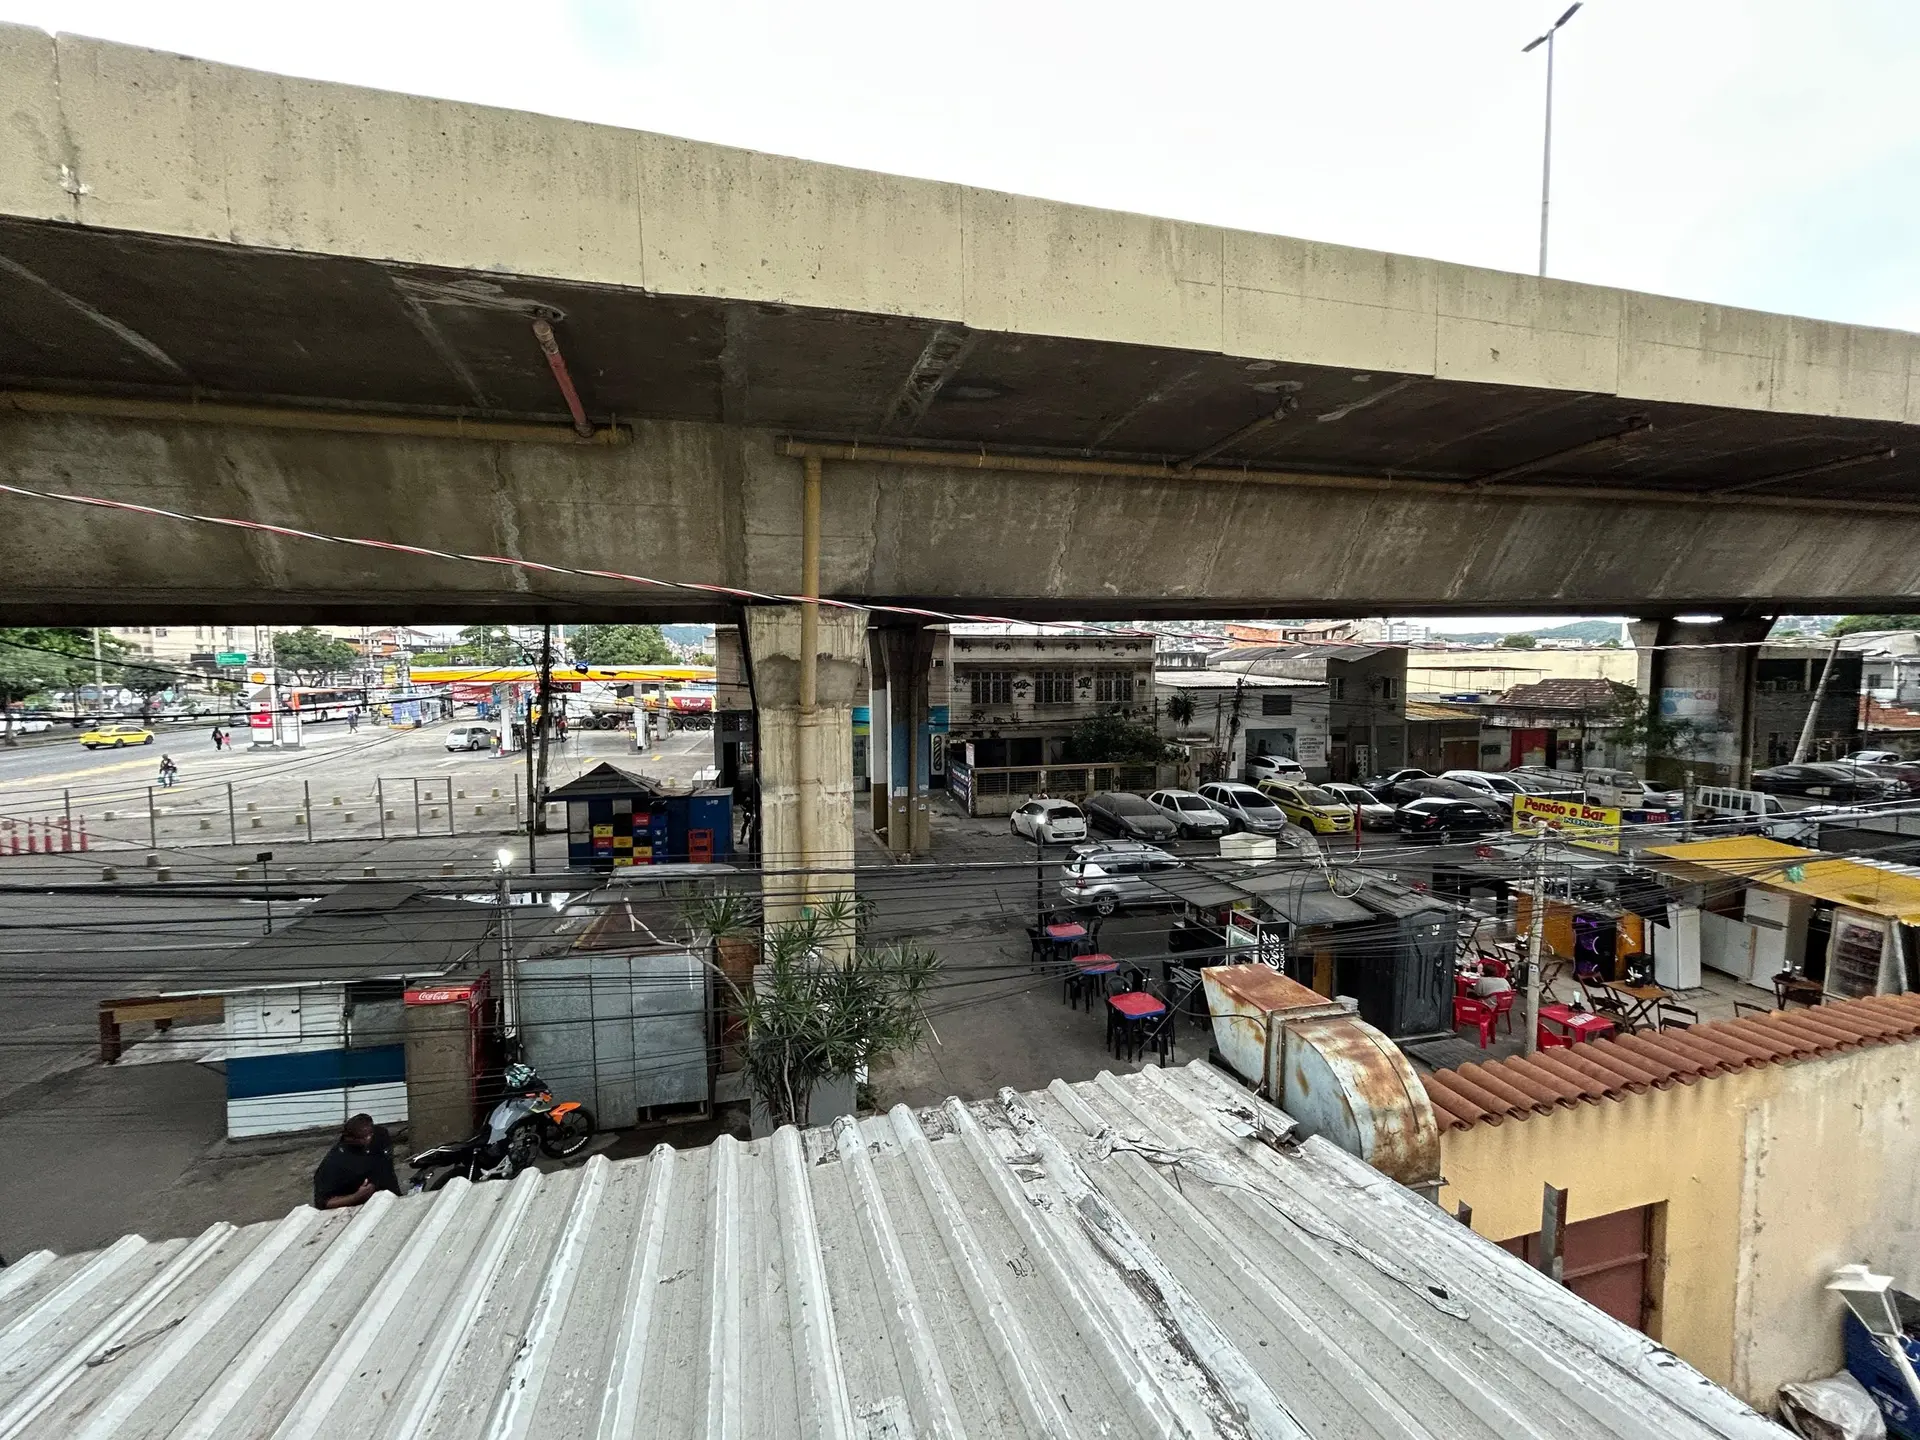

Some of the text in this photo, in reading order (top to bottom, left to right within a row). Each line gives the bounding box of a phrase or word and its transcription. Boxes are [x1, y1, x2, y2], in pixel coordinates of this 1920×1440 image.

[1523, 797, 1607, 821] Pensão e Bar
